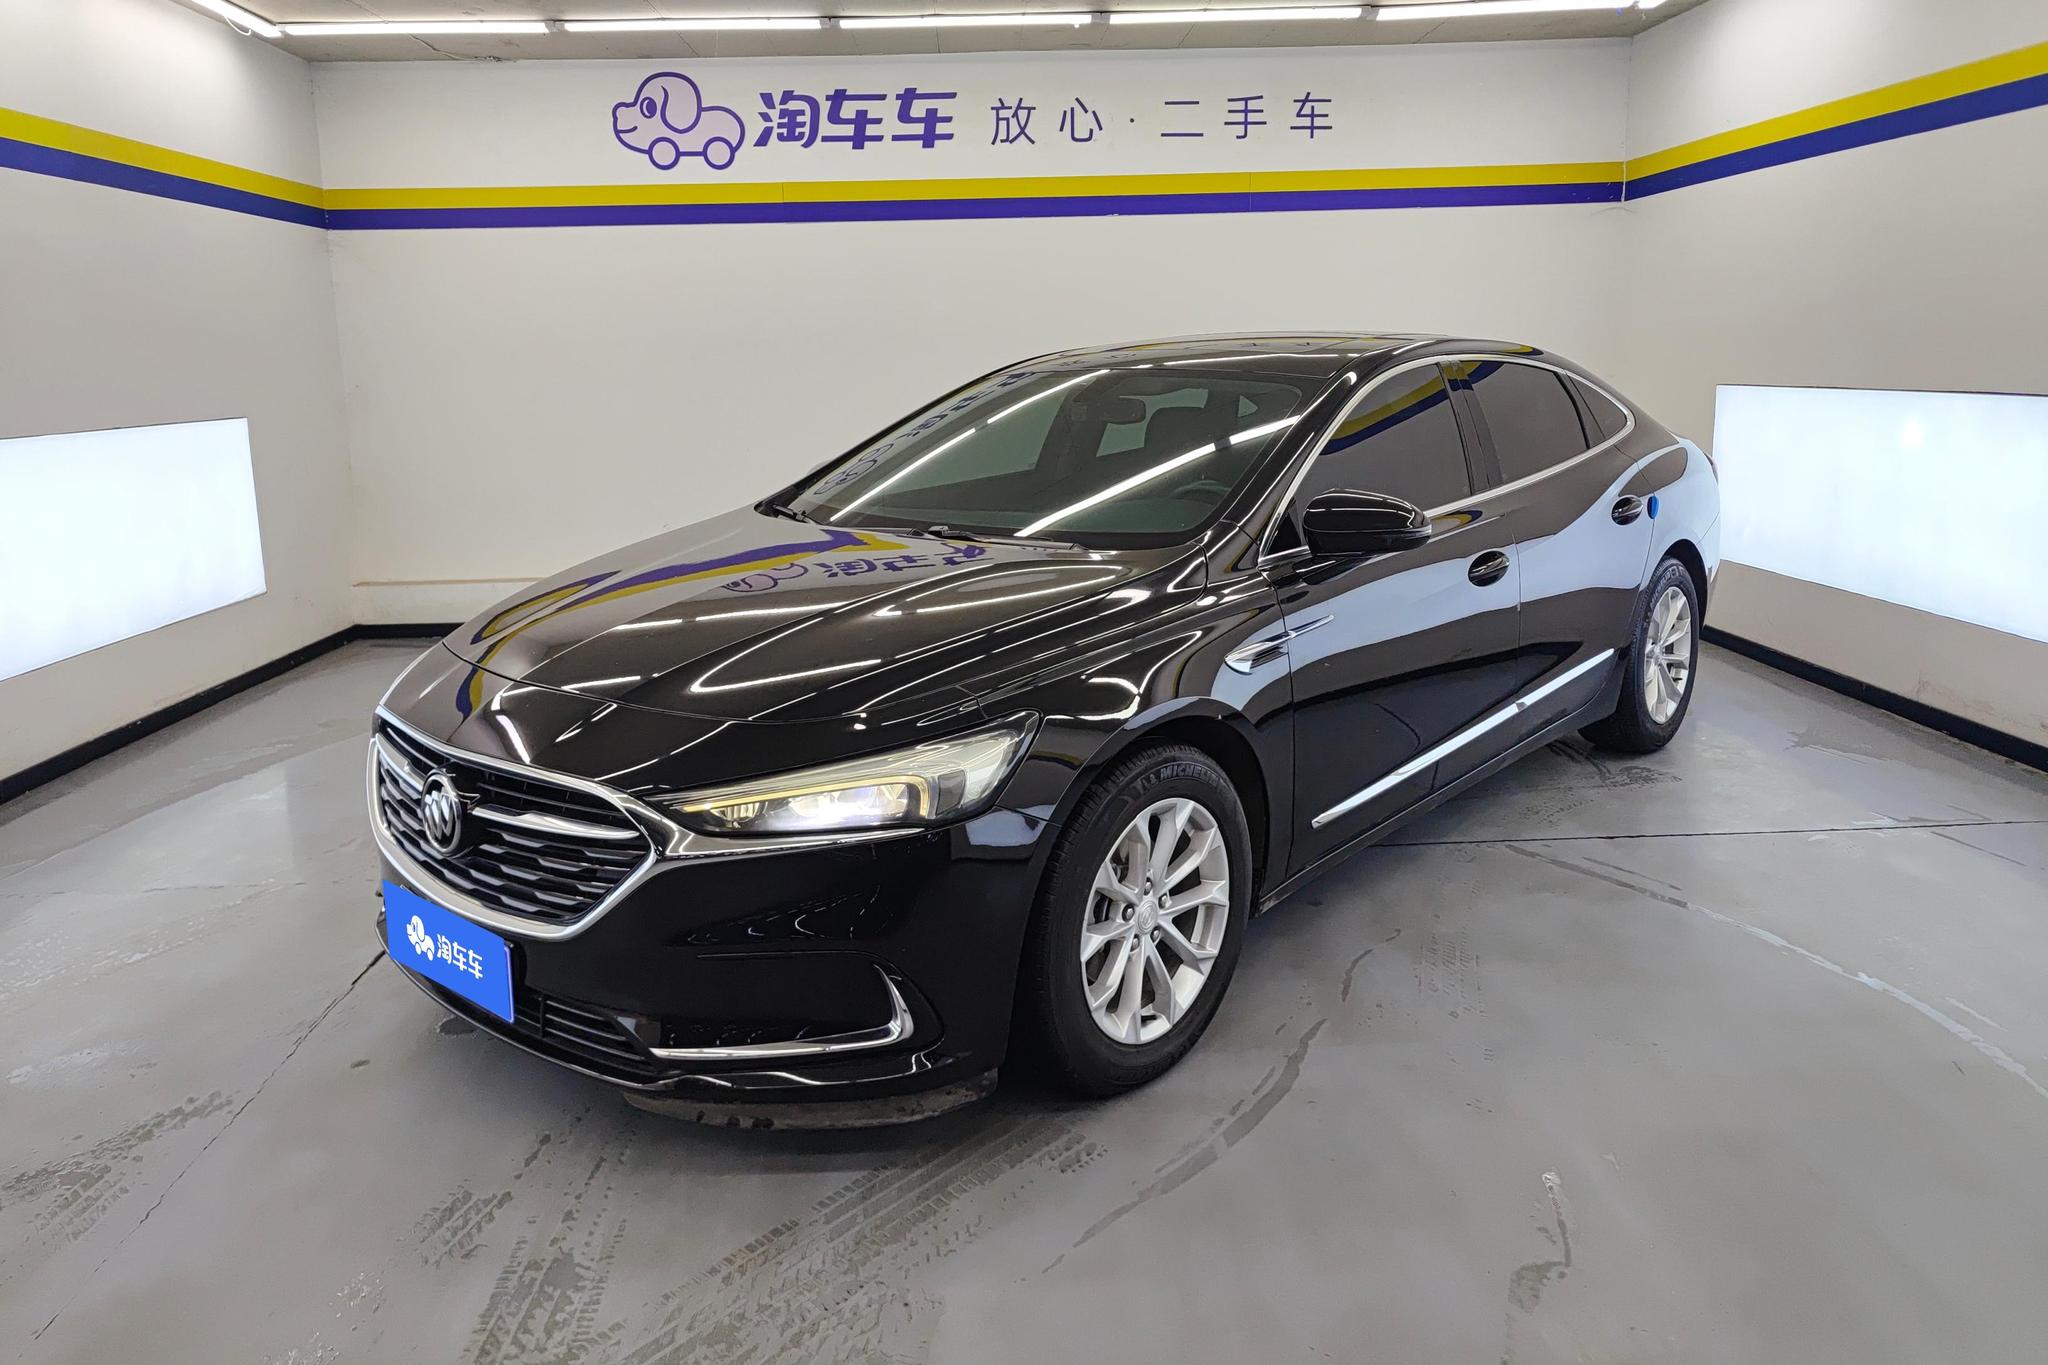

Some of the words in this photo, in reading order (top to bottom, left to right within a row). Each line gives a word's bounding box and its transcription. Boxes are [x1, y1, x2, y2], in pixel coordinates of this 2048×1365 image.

[753, 87, 958, 150] 淘车车
[990, 91, 1334, 146] 放心·二手车
